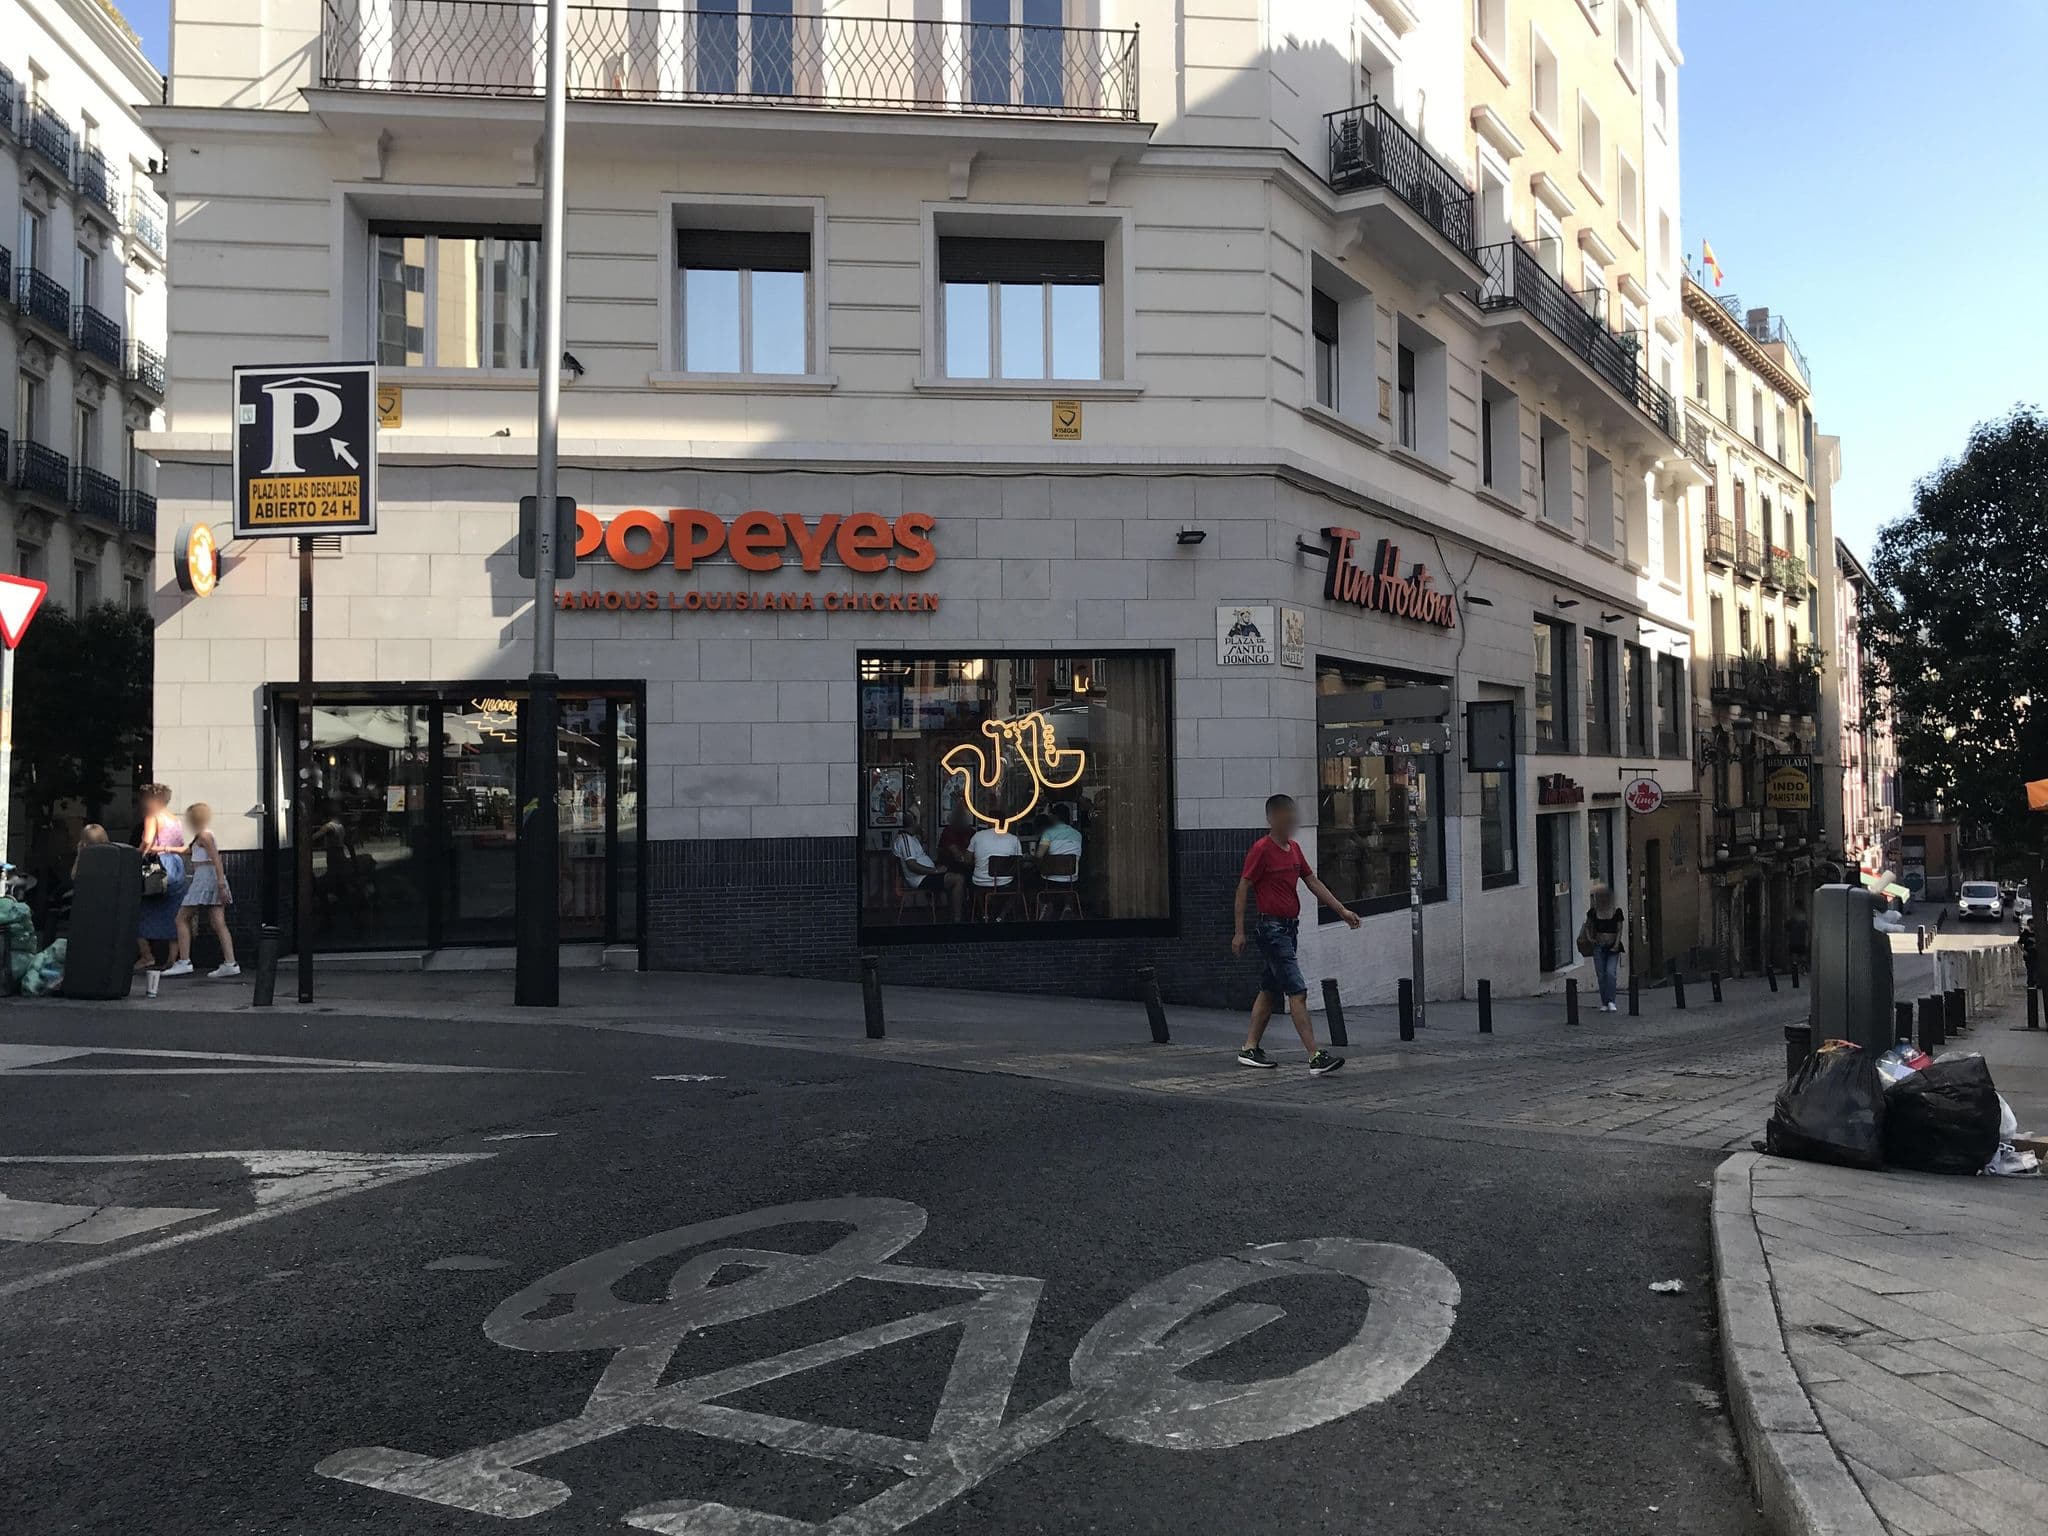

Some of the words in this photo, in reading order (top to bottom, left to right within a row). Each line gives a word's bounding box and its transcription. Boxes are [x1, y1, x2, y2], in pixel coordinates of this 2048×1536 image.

[261, 387, 343, 474] P
[252, 484, 279, 500] PLAZA
[280, 482, 291, 499] DE
[293, 481, 309, 498] LAS
[310, 480, 358, 498] DESCALZAS
[255, 501, 317, 519] ABIERTO
[321, 501, 338, 517] 24
[1321, 526, 1375, 609] Tim
[1376, 538, 1456, 629] Hortons
[668, 591, 815, 611] LOUISIANA
[823, 592, 939, 613] CHICKEN
[1224, 637, 1255, 645] PLAZA
[1228, 645, 1265, 655] SANTO
[1223, 654, 1269, 664] DOMINGO
[1773, 782, 1805, 791] INDO
